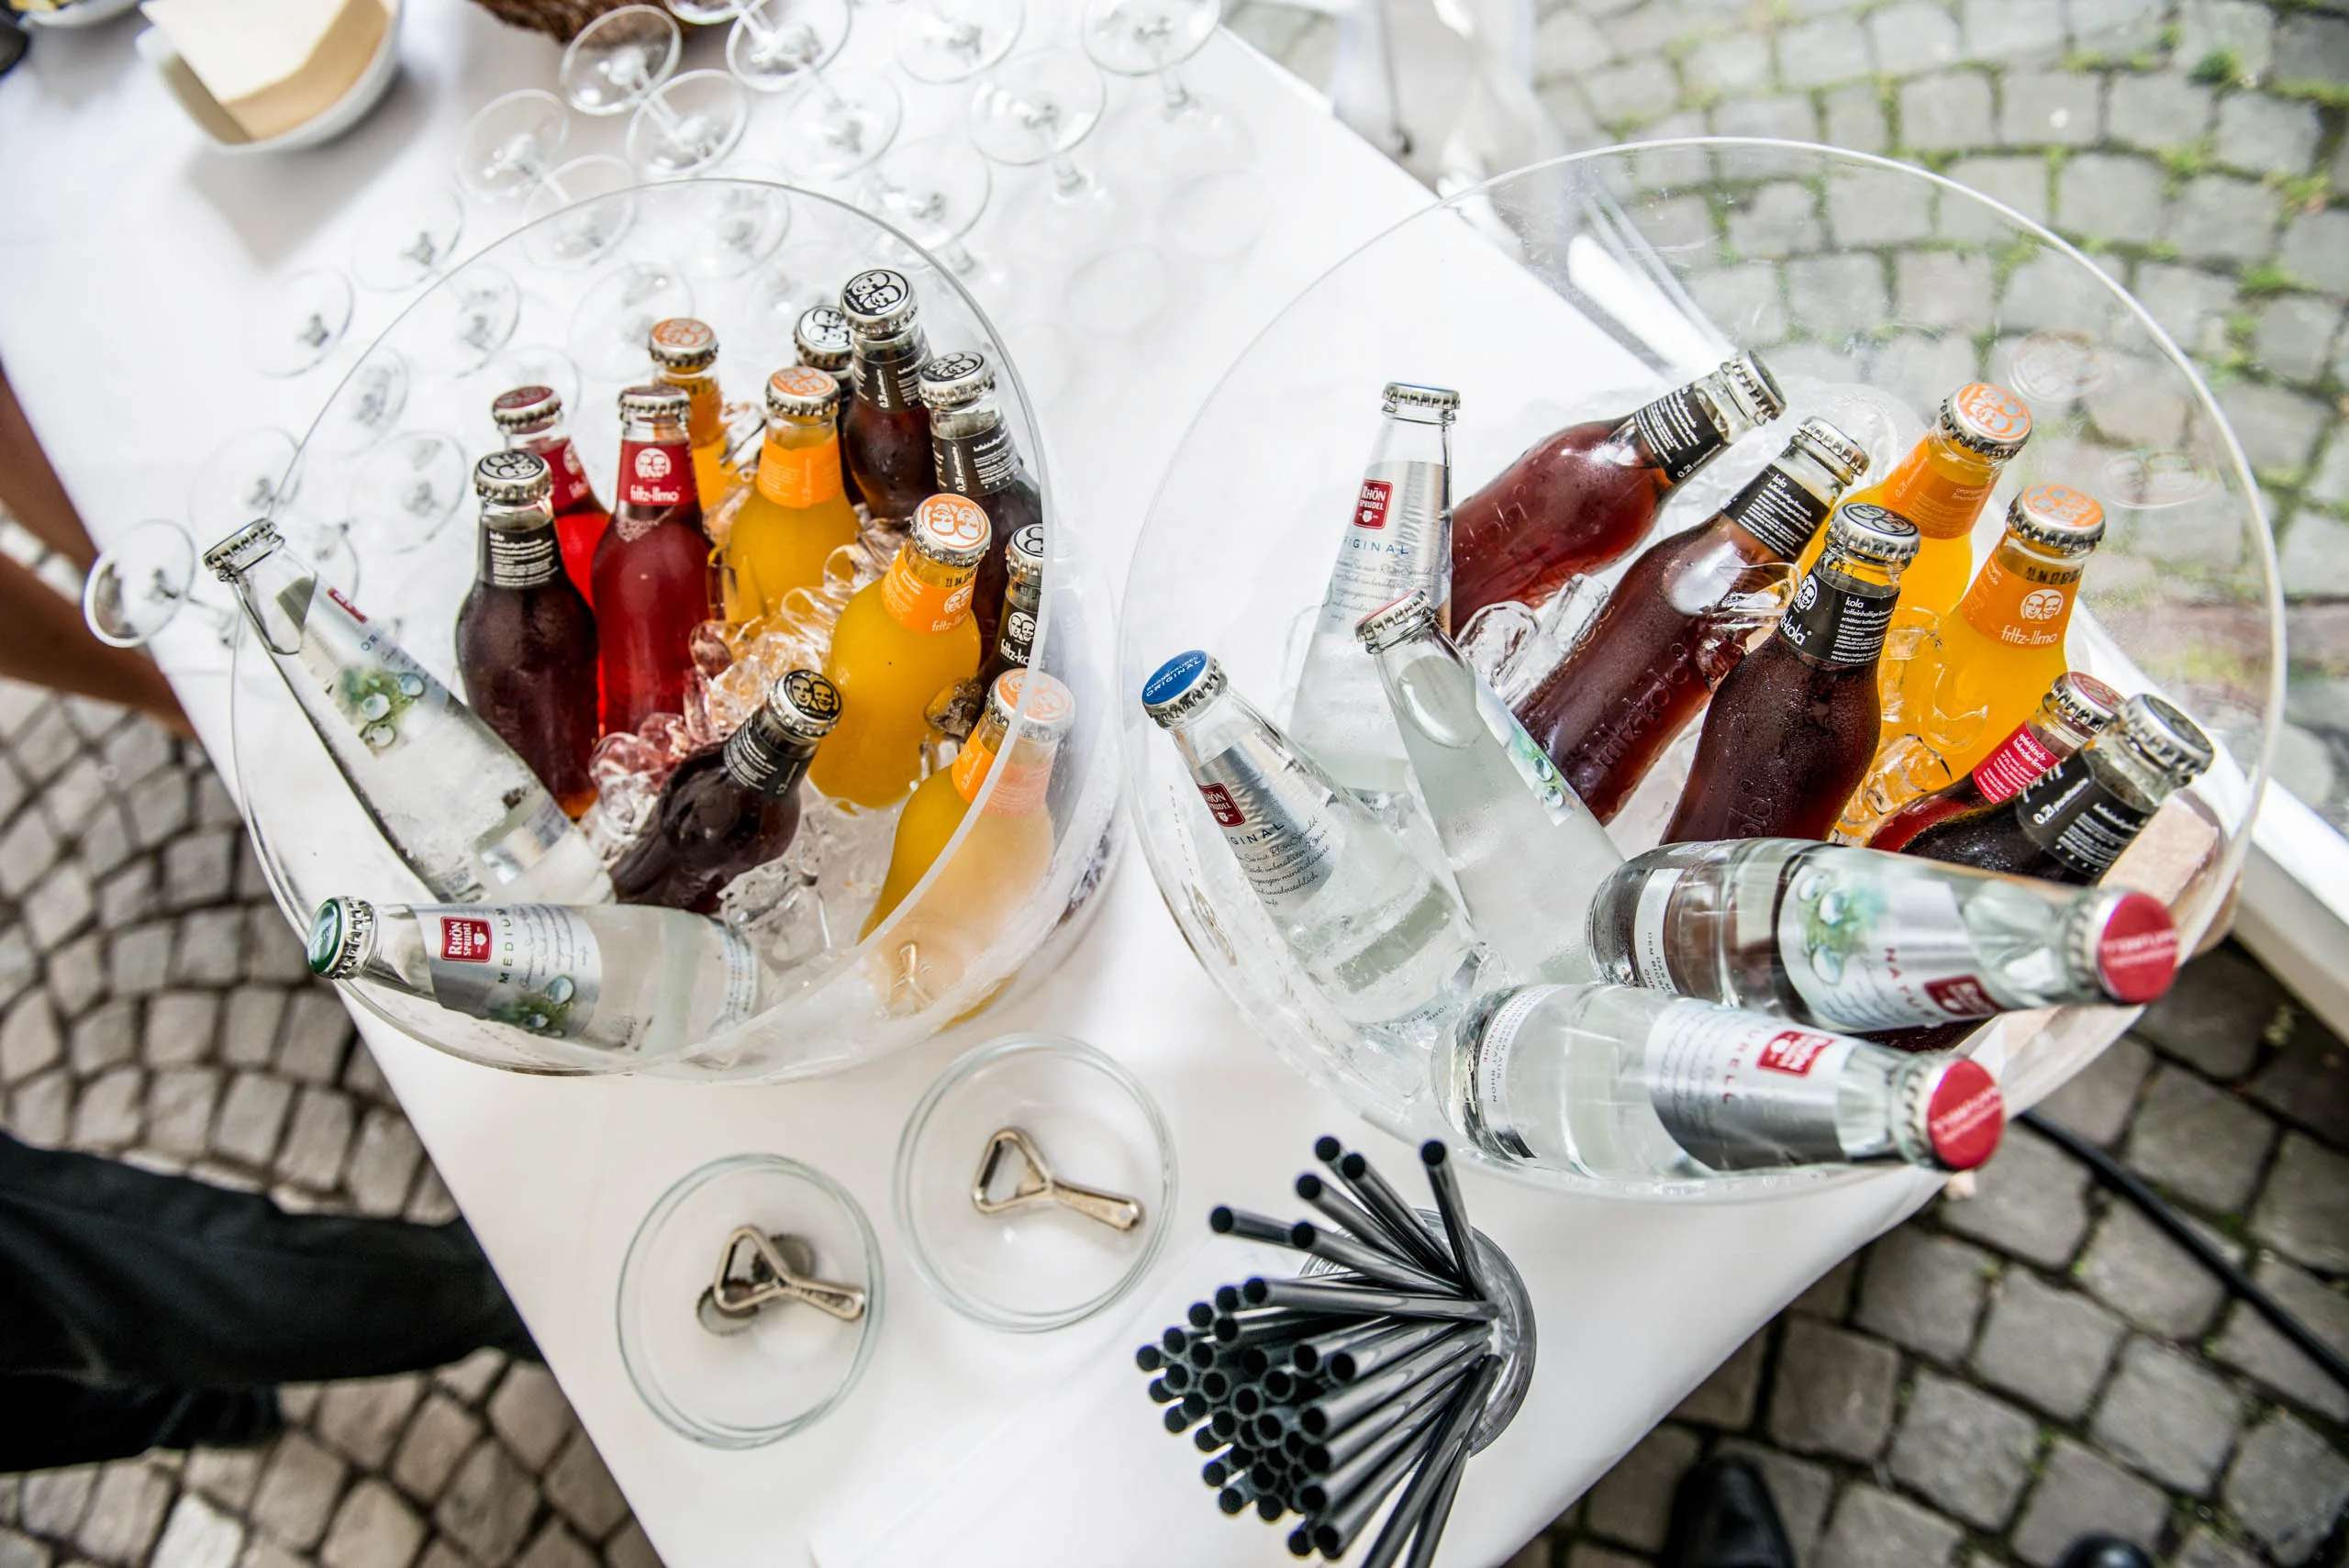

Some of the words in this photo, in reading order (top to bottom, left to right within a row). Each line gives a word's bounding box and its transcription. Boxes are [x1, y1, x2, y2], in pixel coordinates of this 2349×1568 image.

[1361, 484, 1387, 502] RHÖN
[1358, 498, 1385, 511] SPRUDEL
[1844, 595, 1865, 608] kola
[2000, 624, 2059, 646] fritz-limo
[1146, 660, 1202, 697] ORIGINAL
[448, 920, 462, 956] RHÖN
[462, 921, 473, 957] SPRUDEL
